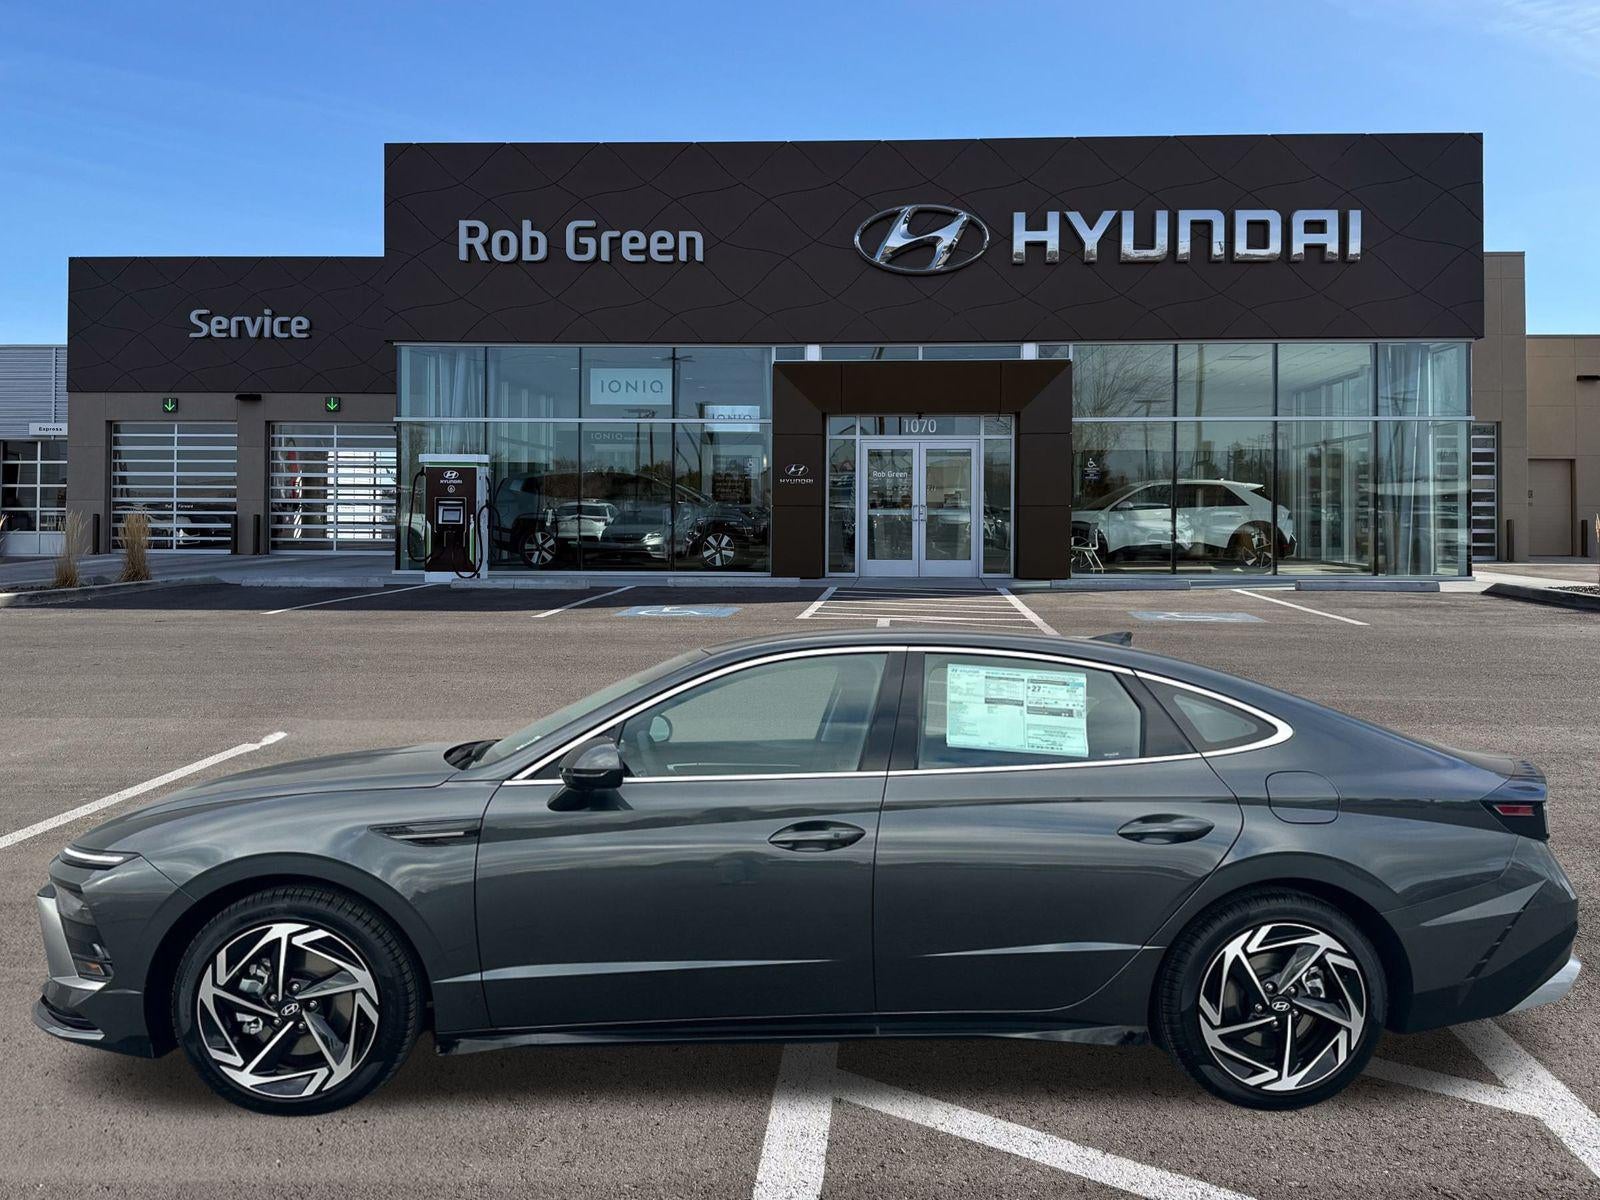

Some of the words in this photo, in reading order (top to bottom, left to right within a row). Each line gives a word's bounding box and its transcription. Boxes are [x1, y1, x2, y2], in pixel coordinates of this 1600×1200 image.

[457, 219, 548, 263] Rob
[565, 219, 704, 263] Green
[1012, 209, 1362, 265] HYUNDAI
[189, 308, 311, 338] Service
[600, 379, 664, 394] IONIQ
[903, 419, 937, 433] 1070
[591, 432, 623, 440] IONIQ
[872, 470, 886, 478] Rob
[887, 470, 908, 478] Green
